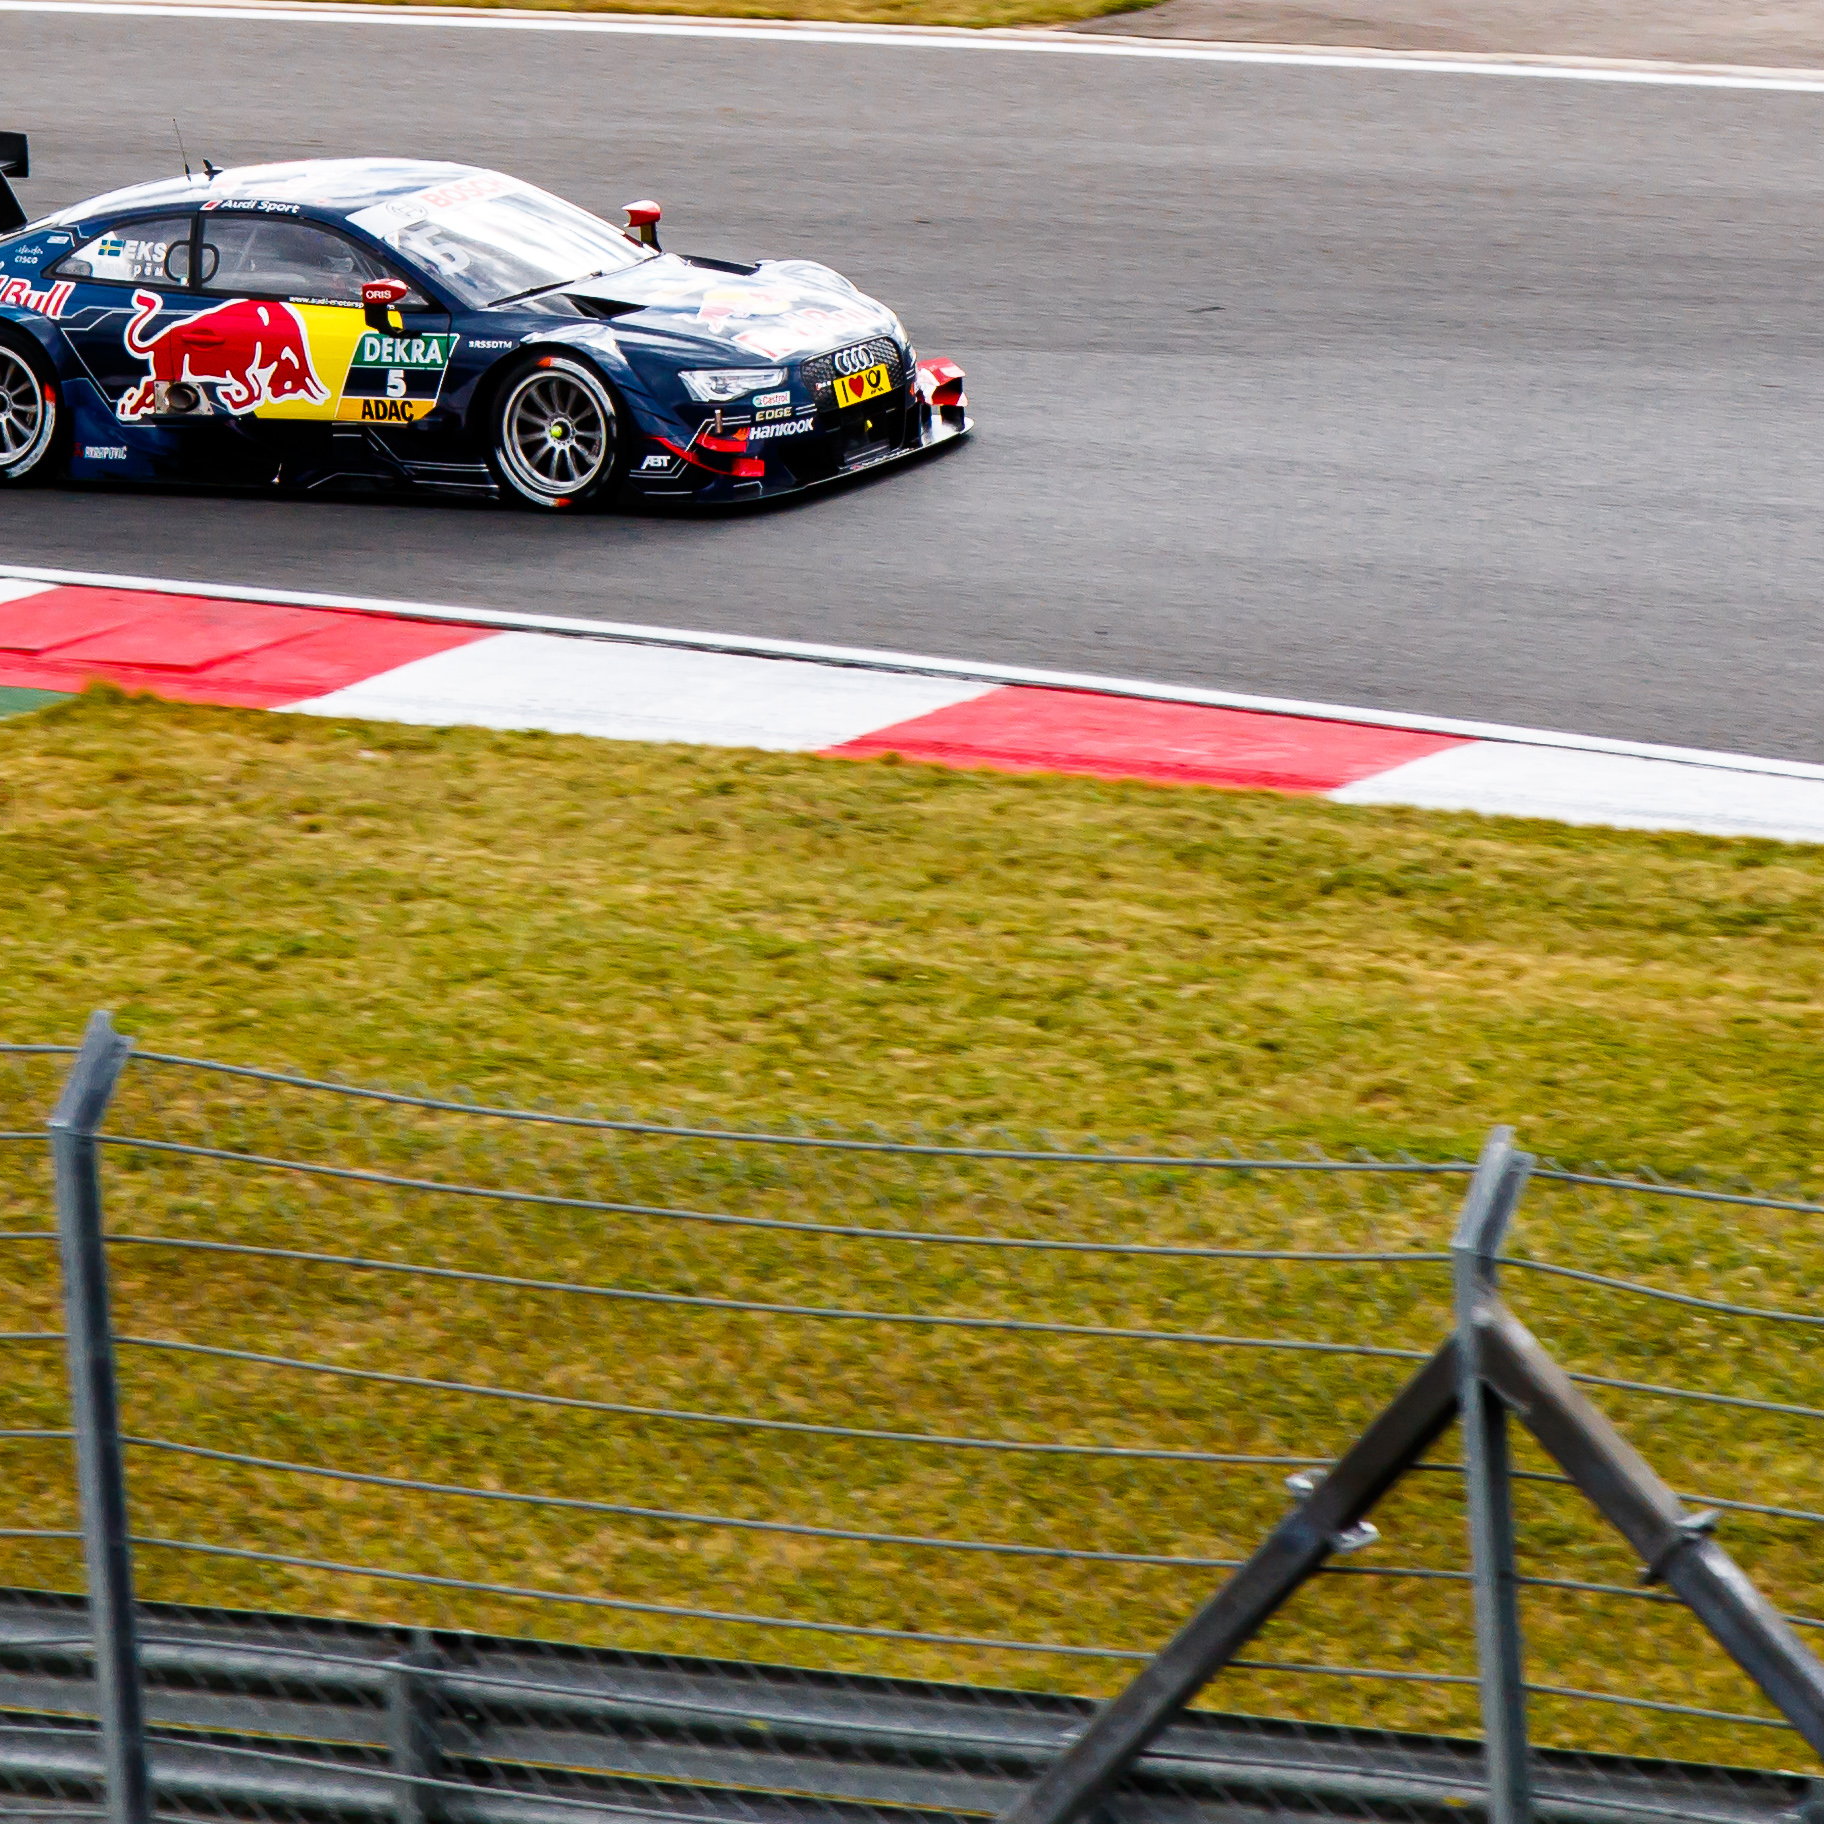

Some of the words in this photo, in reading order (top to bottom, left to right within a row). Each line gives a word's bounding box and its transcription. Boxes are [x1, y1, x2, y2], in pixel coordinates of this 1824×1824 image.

[420, 177, 512, 208] BOSCH
[220, 199, 256, 211] Audi
[258, 200, 300, 215] Sport
[125, 240, 167, 263] EKS
[365, 290, 392, 300] ORIS
[363, 336, 444, 364] DEKRA
[386, 369, 407, 398] 5
[762, 391, 789, 407] Castrol
[361, 398, 414, 422] ADAC
[755, 406, 793, 422] EDGE
[640, 455, 671, 470] ABT
